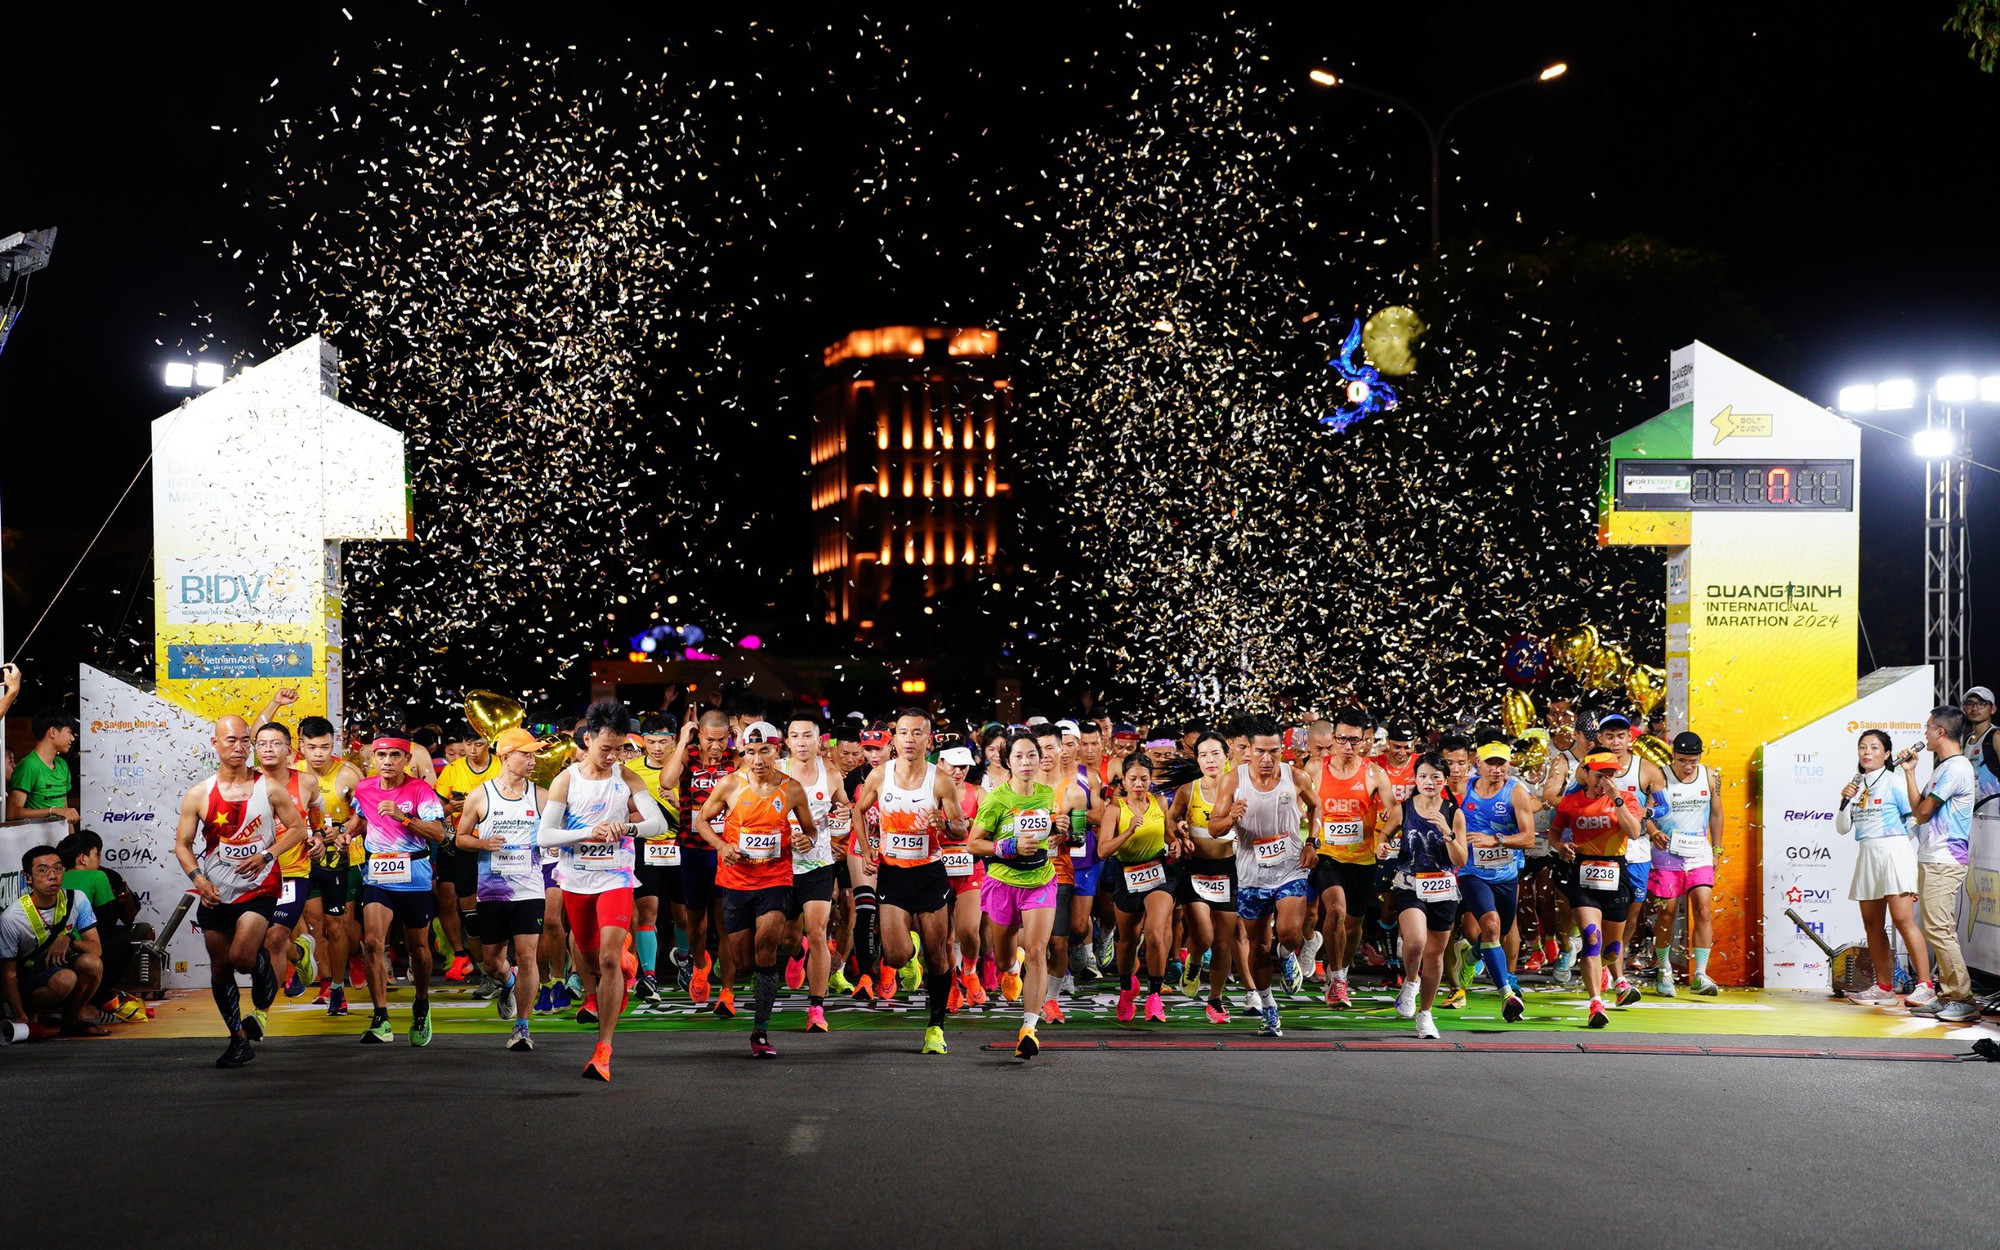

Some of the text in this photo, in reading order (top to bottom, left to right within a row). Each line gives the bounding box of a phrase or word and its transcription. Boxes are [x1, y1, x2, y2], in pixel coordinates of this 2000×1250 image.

[1740, 417, 1762, 425] BOLT
[1740, 425, 1766, 433] EVENT
[181, 574, 267, 604] BIDV
[1706, 602, 1818, 612] INTERNATIONAL
[1706, 615, 1840, 628] MARATHON 2024
[202, 655, 238, 665] Vietnam
[104, 720, 133, 729] Saigon
[1859, 720, 1922, 730] Saigon Uniform
[114, 754, 132, 764] TH
[1794, 753, 1811, 763] TH
[114, 764, 144, 777] true
[1794, 764, 1824, 777] true
[1324, 798, 1360, 813] QBR
[102, 811, 155, 823] ReVive
[1784, 810, 1834, 821] ReVive
[1020, 817, 1048, 829] 9255
[1329, 823, 1359, 834] 9252
[1575, 815, 1612, 830] QBR
[745, 836, 776, 847] 9244
[892, 836, 924, 847] 9154
[1259, 840, 1286, 855] 9182
[224, 844, 258, 858] 9200
[580, 844, 614, 857] 9224
[649, 846, 676, 856] 9174
[1478, 847, 1509, 859] 9315
[373, 860, 405, 872] 9204
[941, 855, 969, 866] 9346
[1130, 867, 1159, 883] 9210
[1585, 867, 1615, 879] 9238
[1421, 879, 1451, 891] 9228
[1803, 889, 1830, 899] PVI
